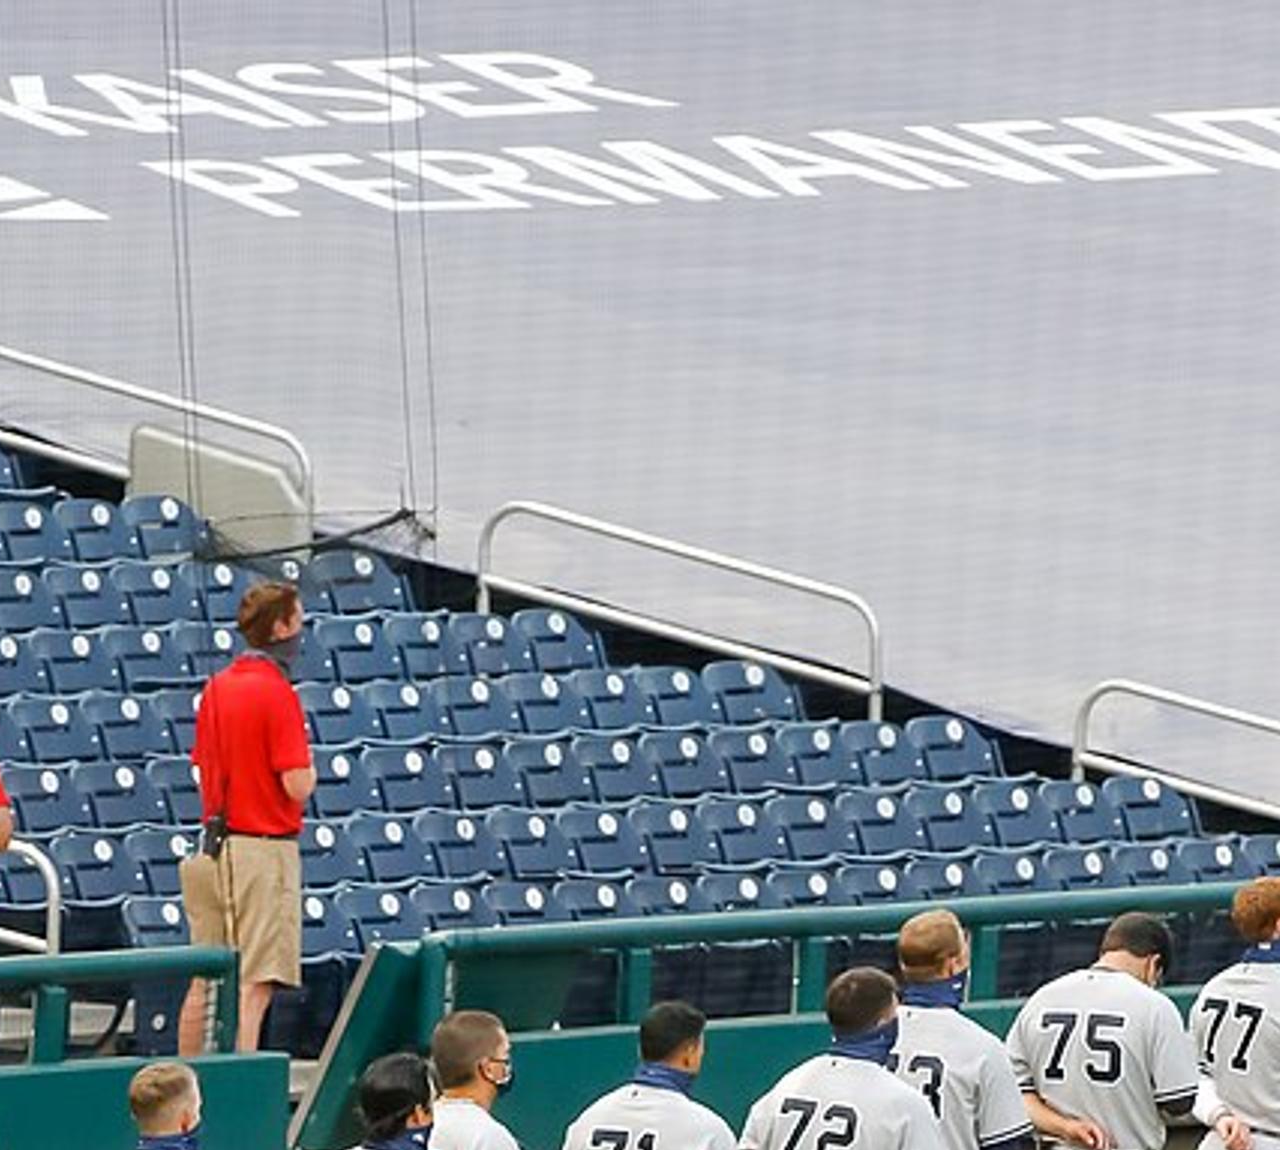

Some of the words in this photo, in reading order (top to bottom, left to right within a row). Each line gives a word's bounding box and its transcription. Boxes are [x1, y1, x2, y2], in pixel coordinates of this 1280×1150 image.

[1040, 1011, 1126, 1084] 75
[1200, 997, 1263, 1071] 77
[884, 1052, 945, 1120] 3
